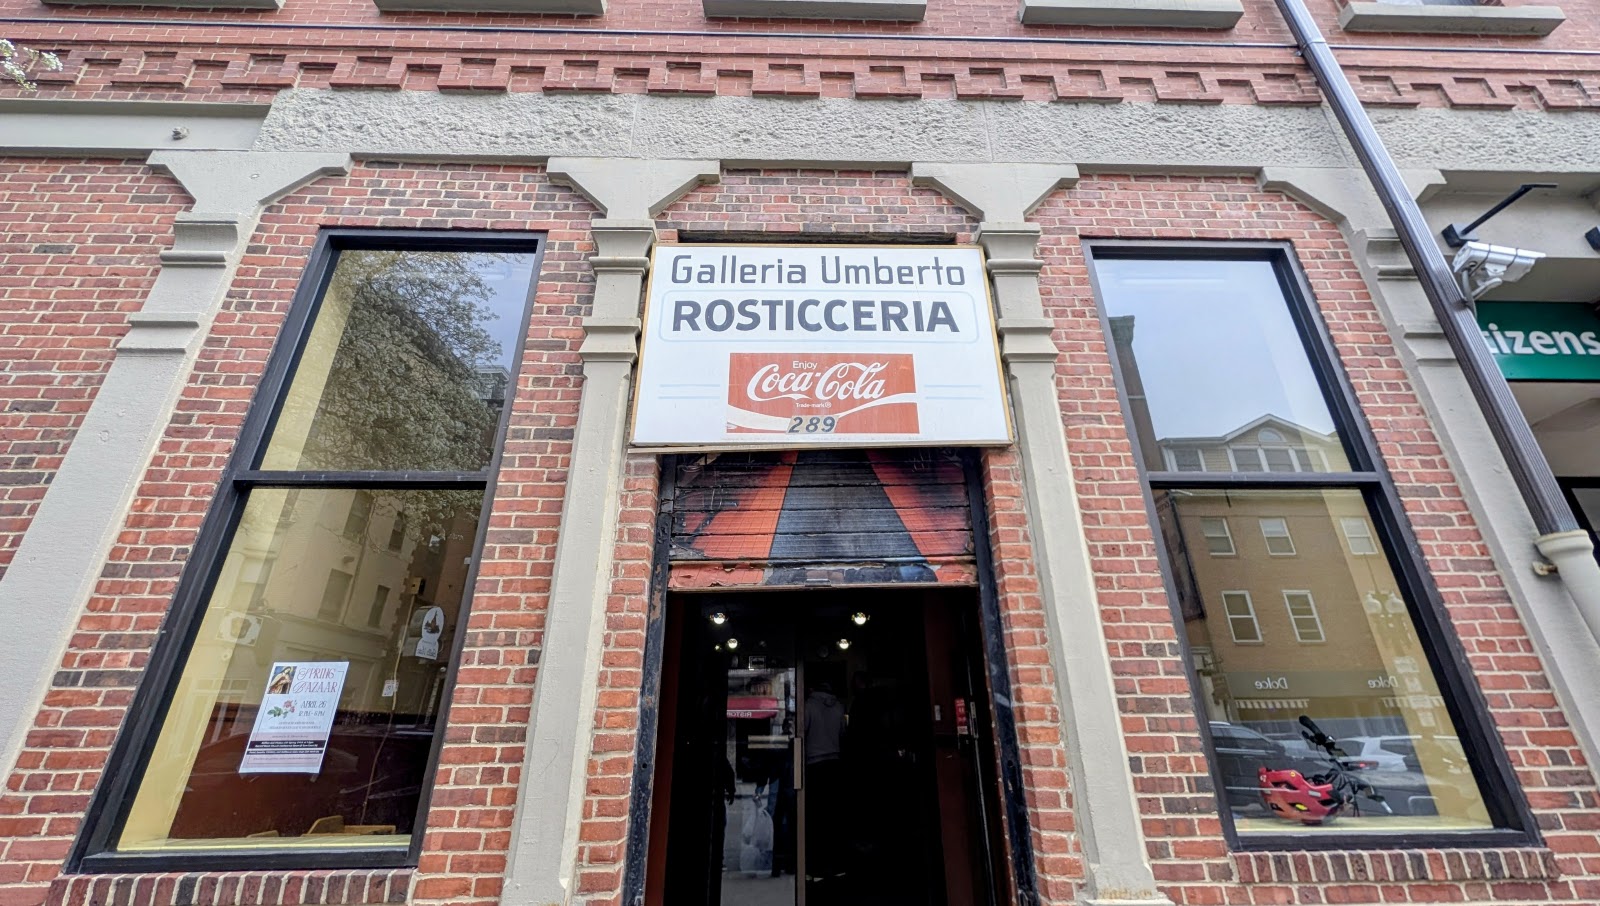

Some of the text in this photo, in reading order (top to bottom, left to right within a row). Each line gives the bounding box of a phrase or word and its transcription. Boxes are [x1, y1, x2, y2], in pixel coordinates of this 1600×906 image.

[671, 255, 966, 286] Galleria Umberto
[672, 299, 960, 333] ROSTICCERIA
[792, 360, 818, 370] Enjoy
[747, 361, 889, 402] Coca-Cola
[788, 416, 837, 433] 289
[297, 667, 336, 680] SPRING
[292, 681, 338, 694] BAZAAR
[300, 700, 318, 709] APRIL
